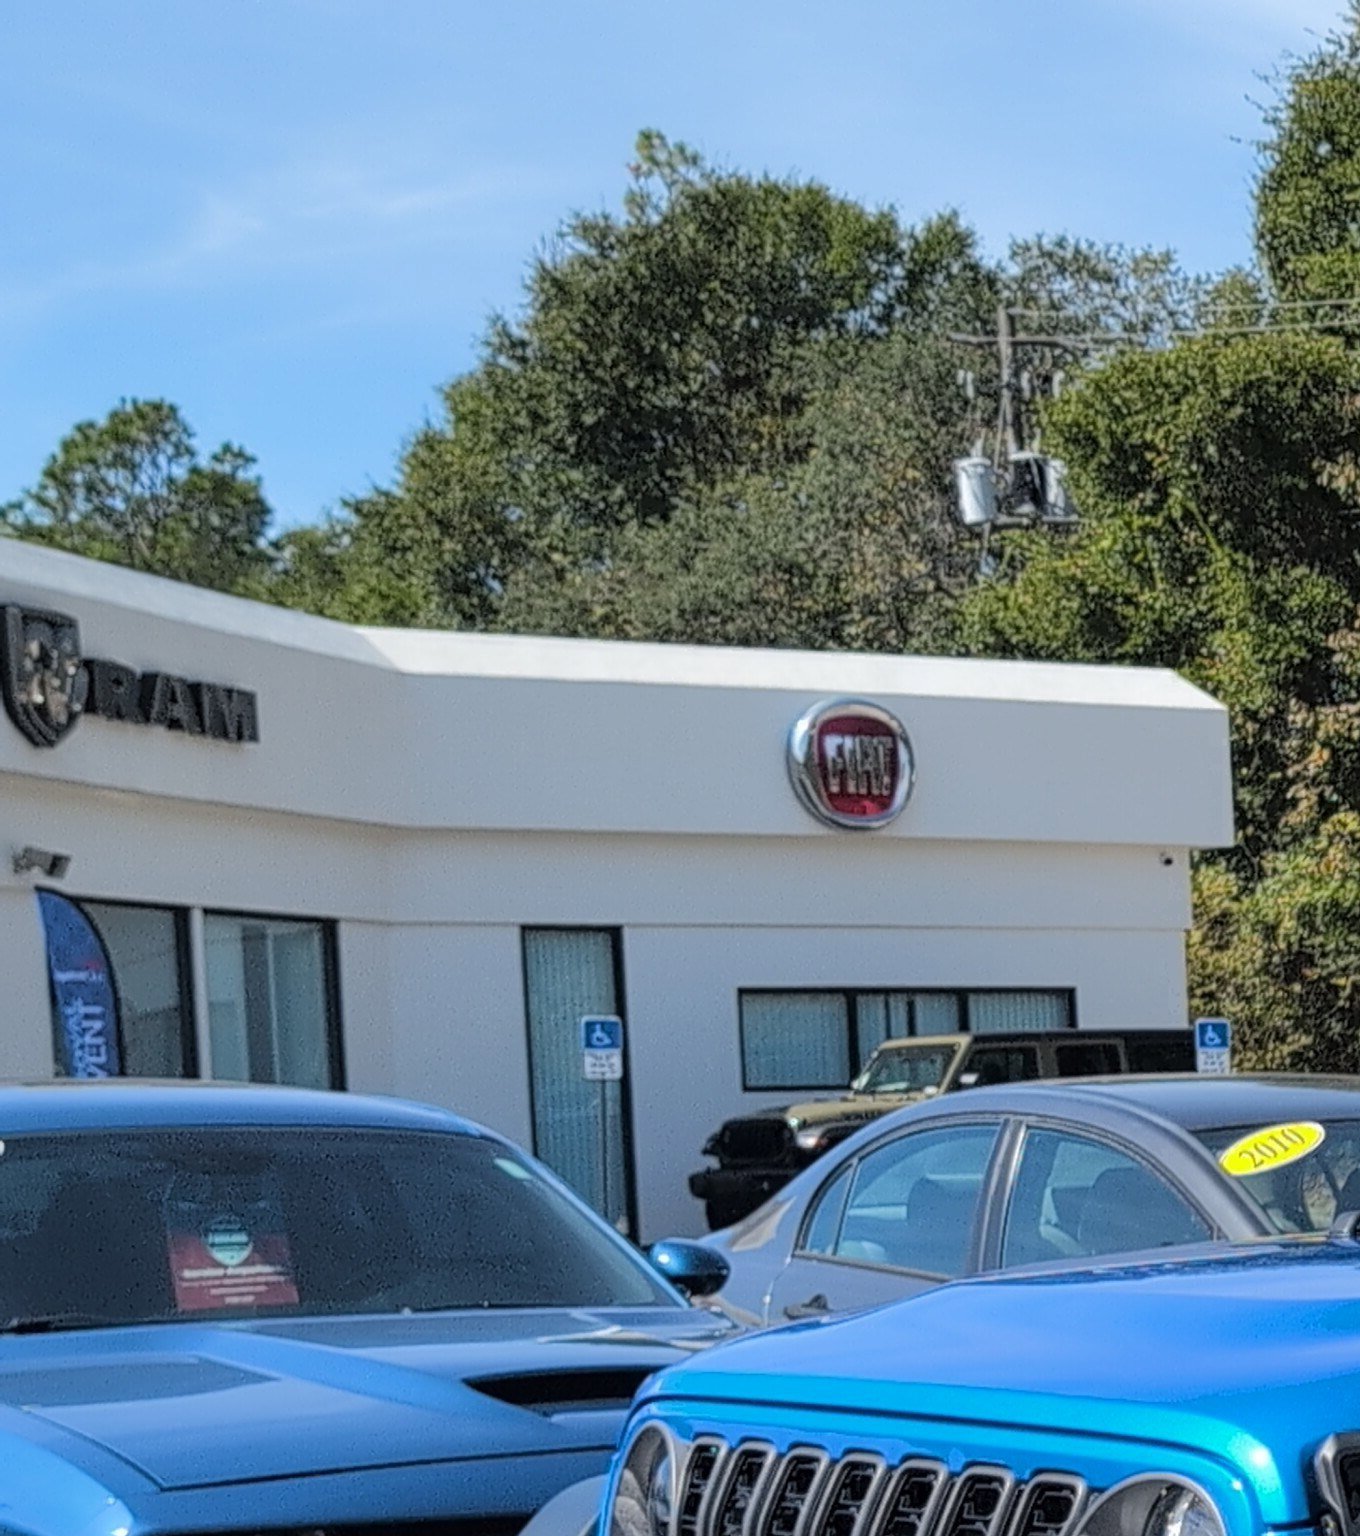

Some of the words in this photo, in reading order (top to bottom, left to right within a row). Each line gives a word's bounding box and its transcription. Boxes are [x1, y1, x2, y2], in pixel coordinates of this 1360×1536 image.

[84, 658, 259, 742] RAM
[824, 734, 893, 796] FIAT
[1238, 1128, 1305, 1168] 2010
